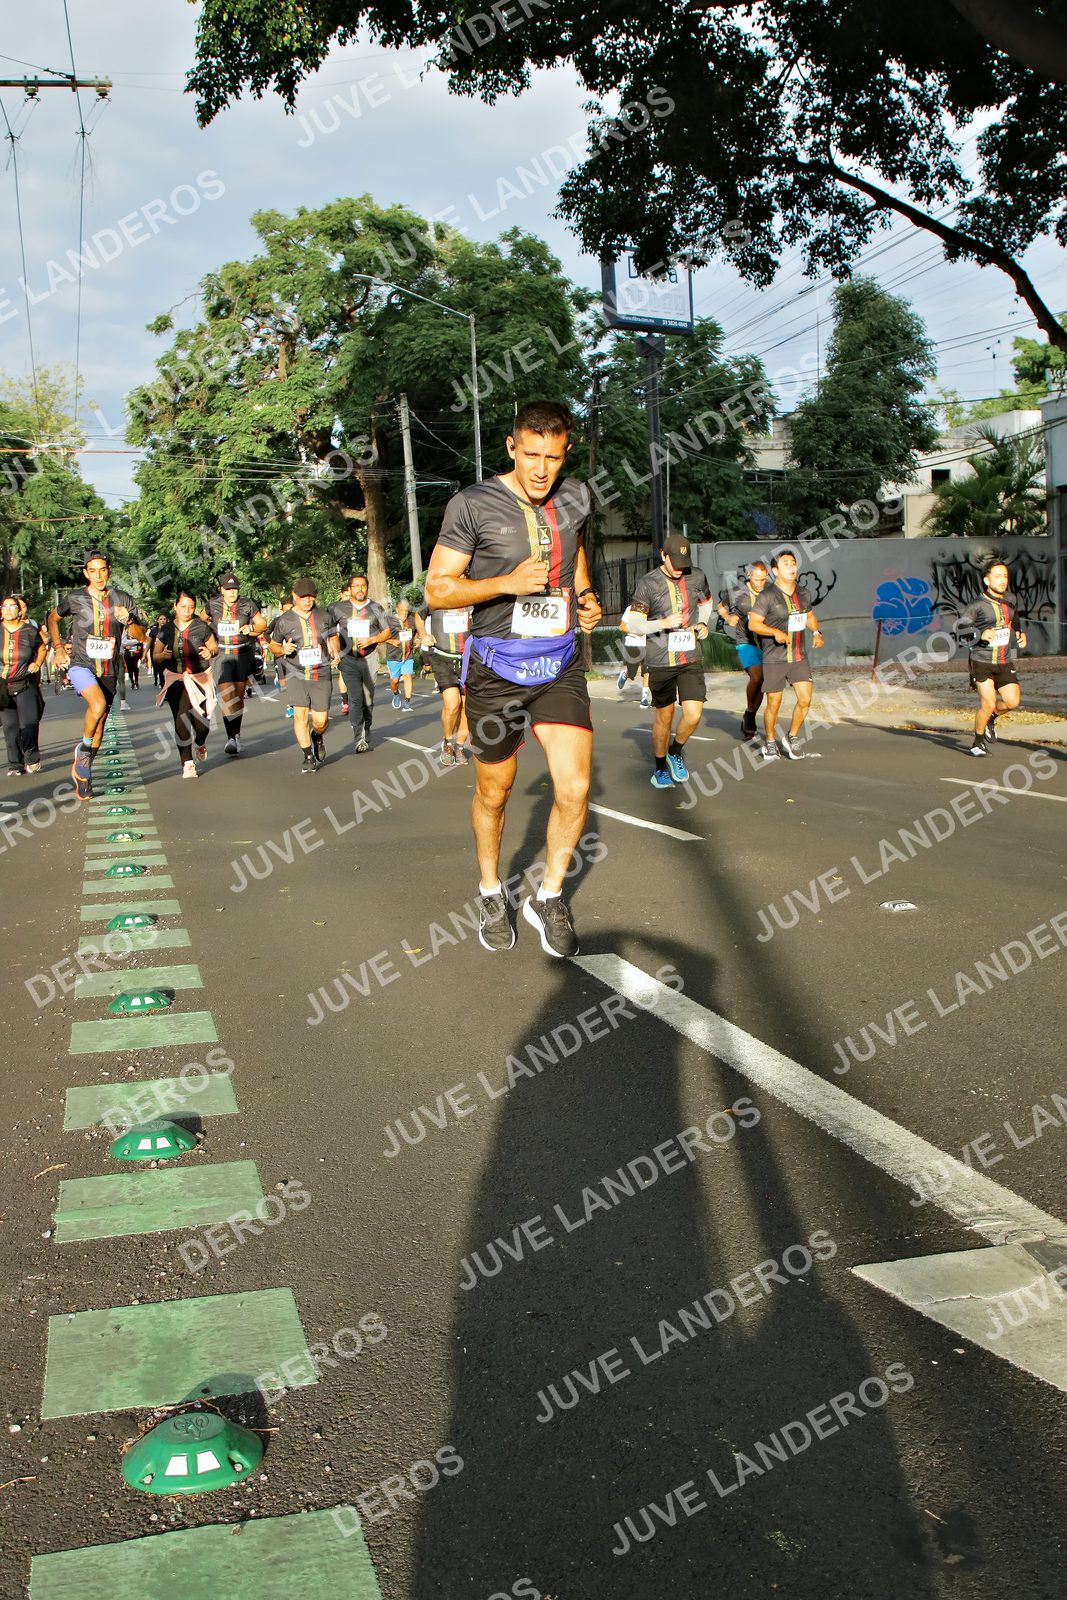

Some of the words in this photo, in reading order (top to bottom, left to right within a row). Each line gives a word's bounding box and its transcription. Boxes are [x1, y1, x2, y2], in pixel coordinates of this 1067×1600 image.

[521, 602, 560, 620] 9862
[673, 634, 691, 643] 7379
[90, 642, 109, 650] 9367
